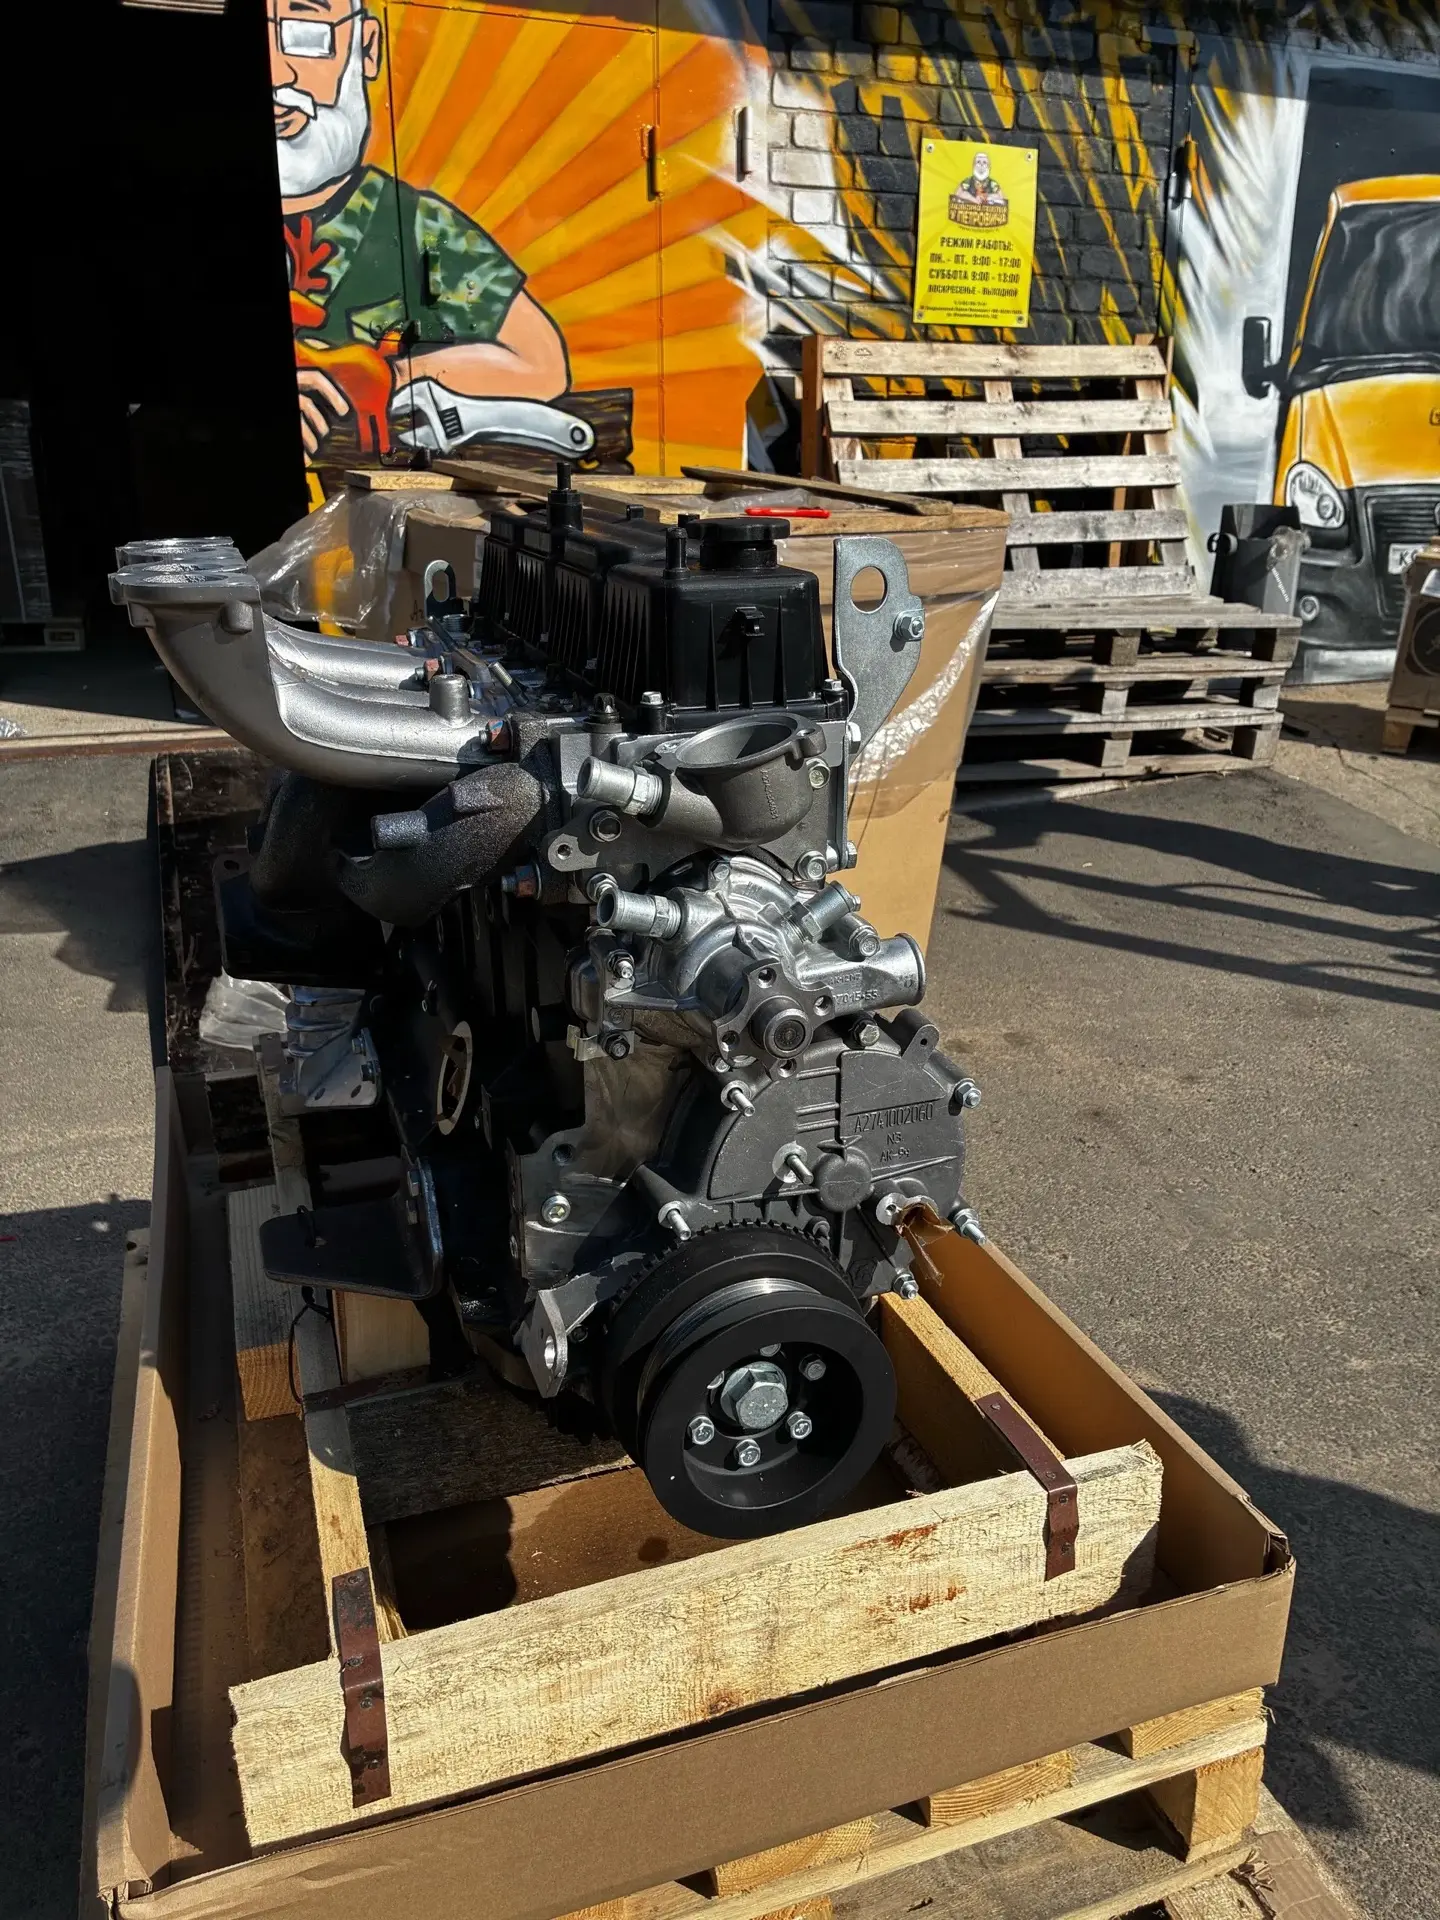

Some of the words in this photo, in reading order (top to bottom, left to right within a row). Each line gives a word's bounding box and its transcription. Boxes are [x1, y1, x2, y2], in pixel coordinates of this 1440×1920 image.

[940, 237, 973, 249] РЕЖИМ
[976, 238, 1014, 251] РАБОТЫ:
[930, 253, 945, 264] ПН.
[954, 254, 968, 265] ПТ.
[972, 255, 991, 267] 9:00
[999, 257, 1021, 269] 17:00
[929, 268, 969, 280] СУББОТА
[971, 271, 990, 281] 9:00
[928, 284, 976, 295] ВОСКРЕСЕНЬЕ
[982, 287, 1018, 297] ВЫХОДНОЙ
[855, 1102, 933, 1133] A2741002060
